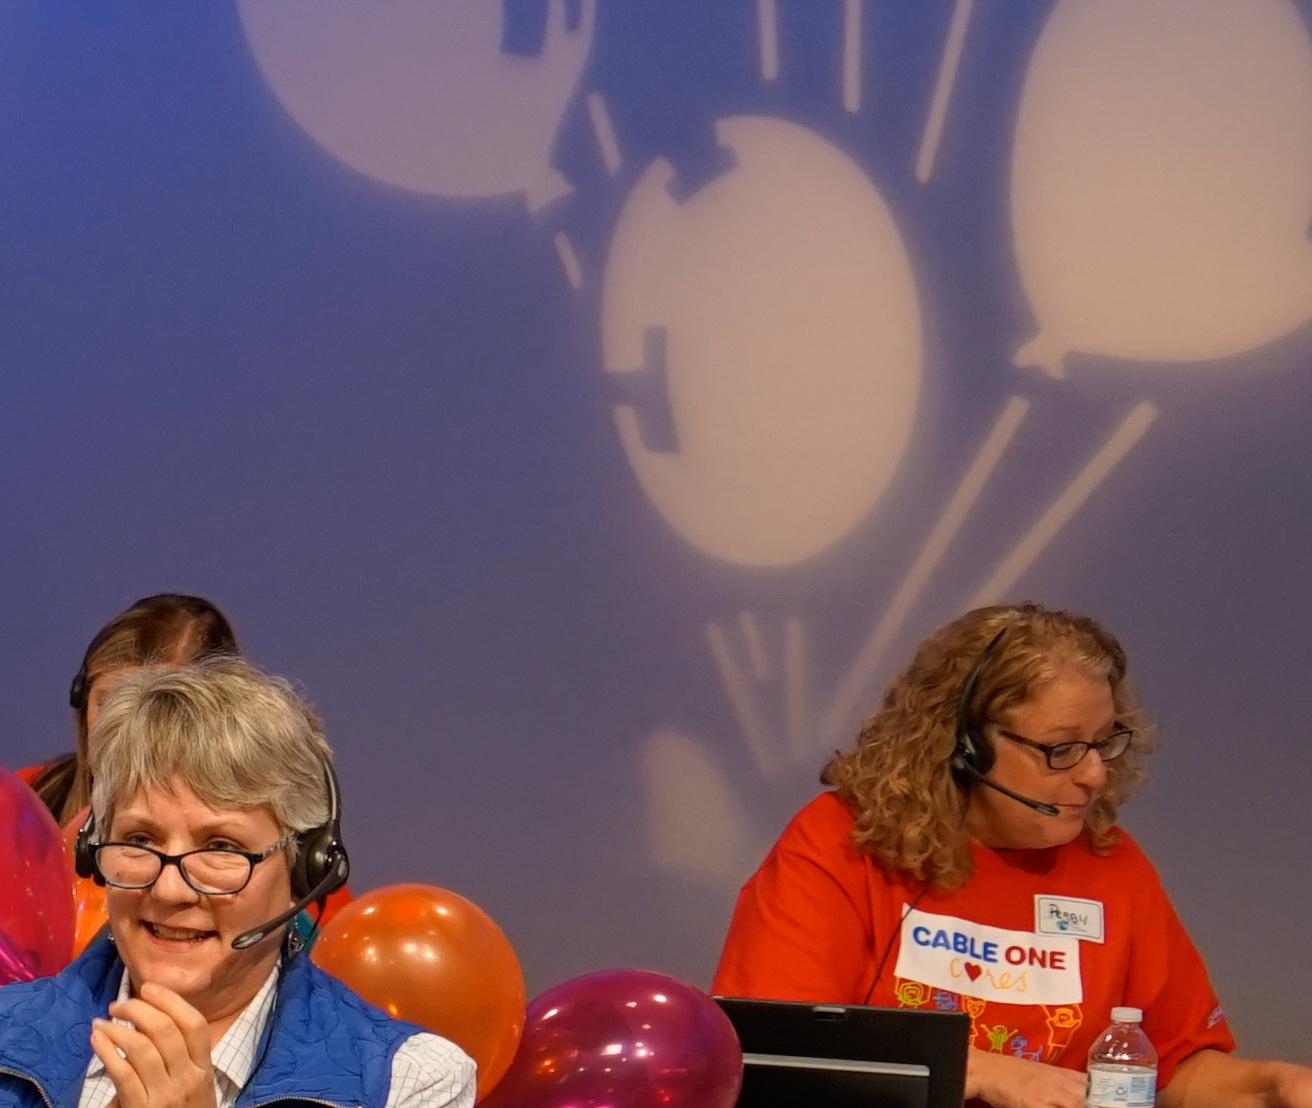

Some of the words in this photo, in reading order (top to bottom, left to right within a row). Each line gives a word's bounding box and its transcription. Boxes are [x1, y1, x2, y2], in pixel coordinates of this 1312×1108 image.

[912, 926, 999, 963] CABLE
[1005, 945, 1067, 970] ONE
[949, 957, 1027, 993] Cres
